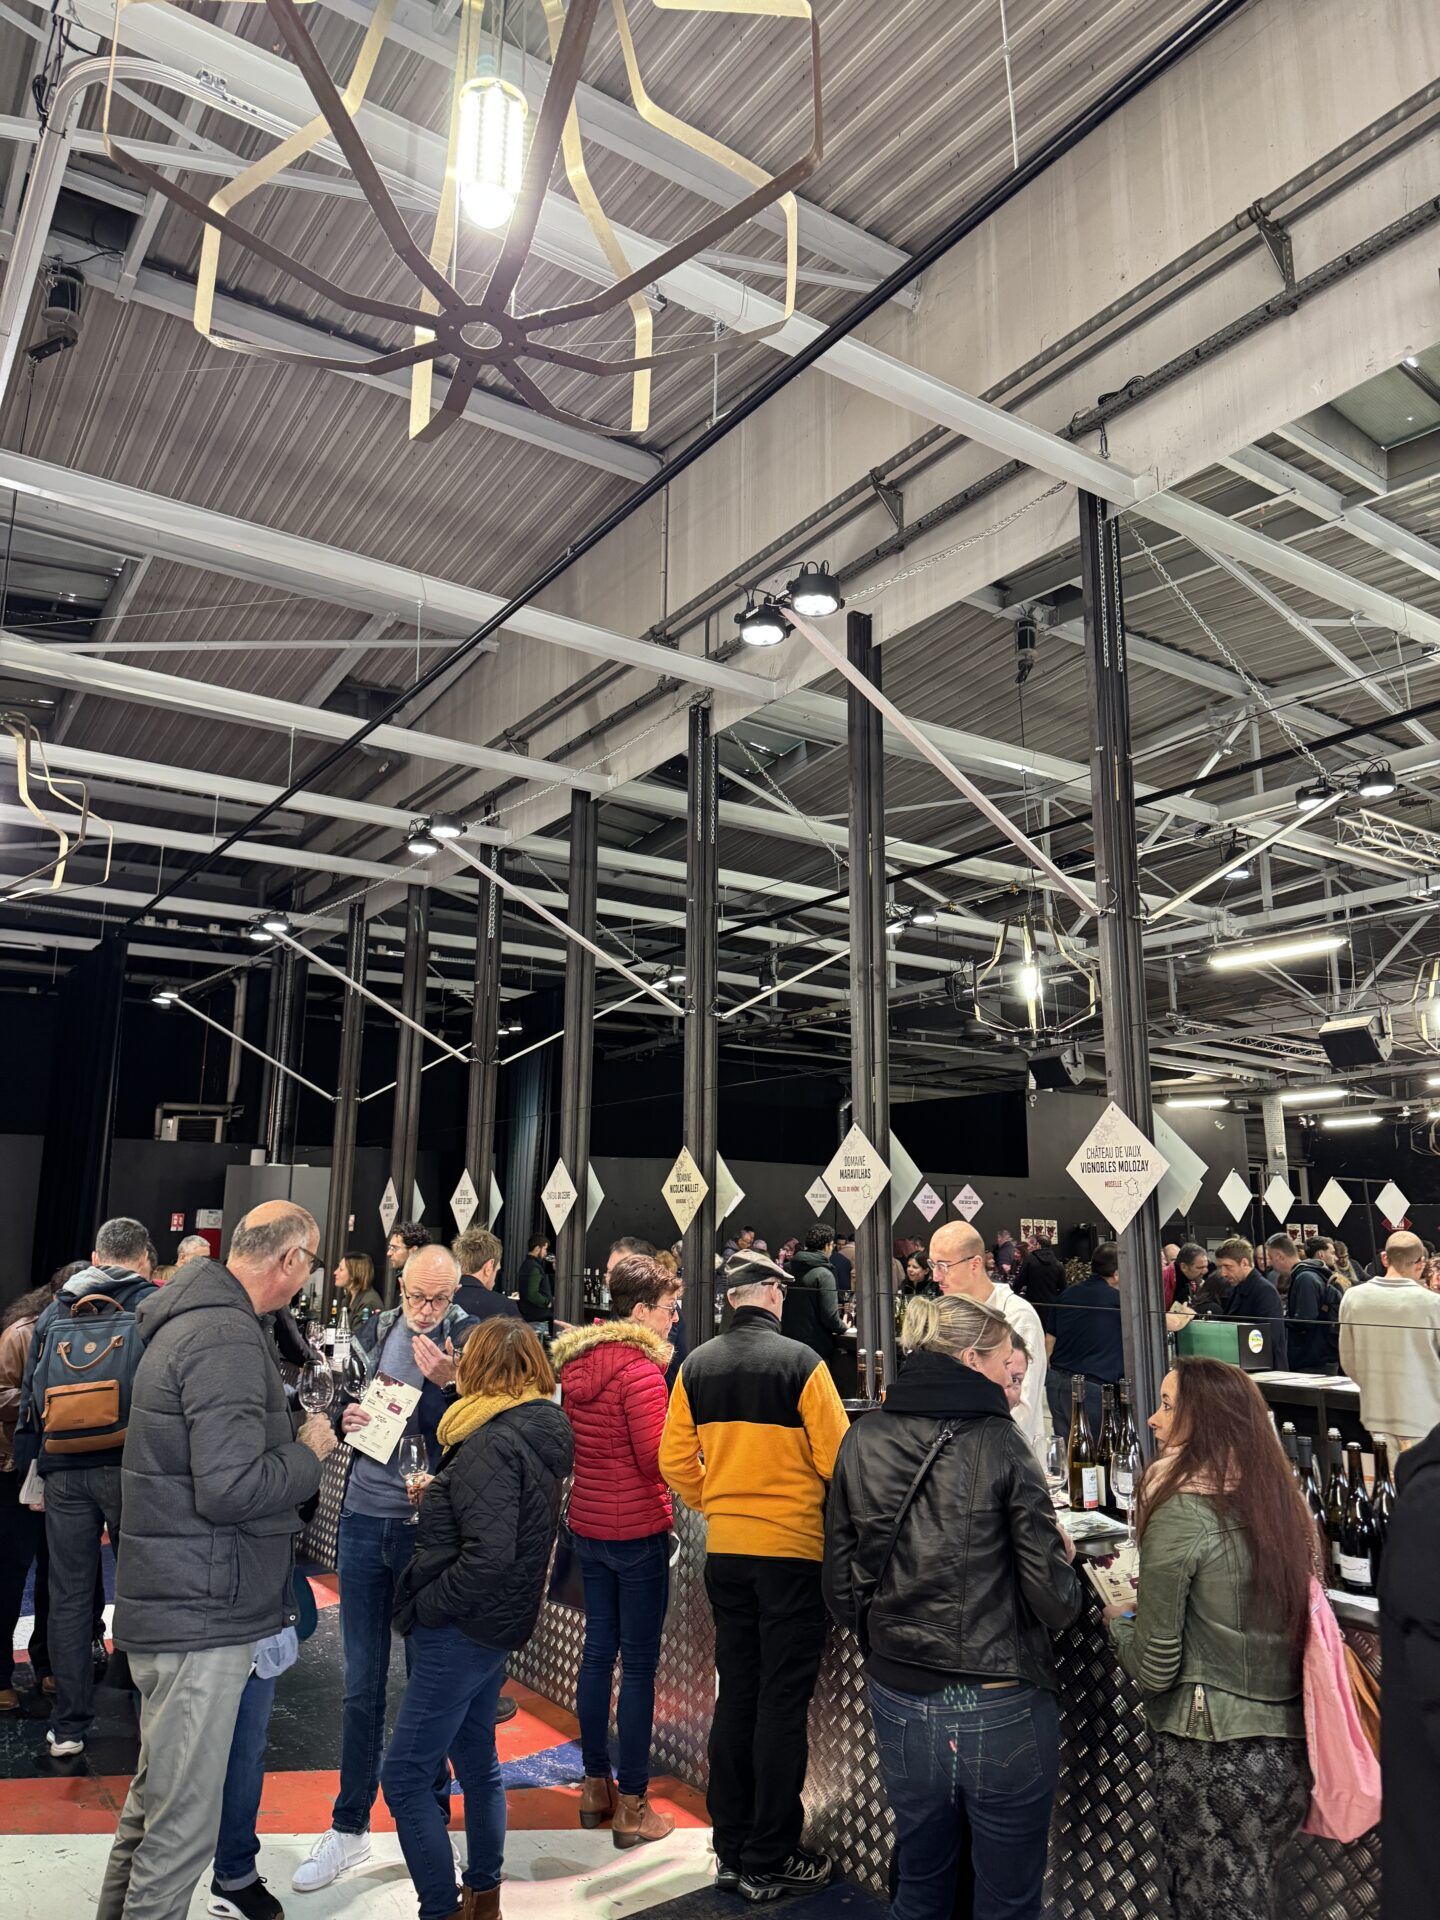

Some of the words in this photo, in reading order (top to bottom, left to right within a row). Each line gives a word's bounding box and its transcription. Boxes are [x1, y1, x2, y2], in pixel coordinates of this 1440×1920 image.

[1086, 1146, 1114, 1159] CHÂTEAU
[1115, 1146, 1123, 1159] DE
[1124, 1145, 1142, 1158] VAUX
[844, 1155, 866, 1167] DOMAINE
[1080, 1161, 1117, 1174] VIGNOBLES
[1118, 1159, 1150, 1173] MOLOZAY
[839, 1168, 872, 1180] MARAVILHAS
[670, 1184, 684, 1193] NICOLAS
[684, 1183, 699, 1193] MAILLET
